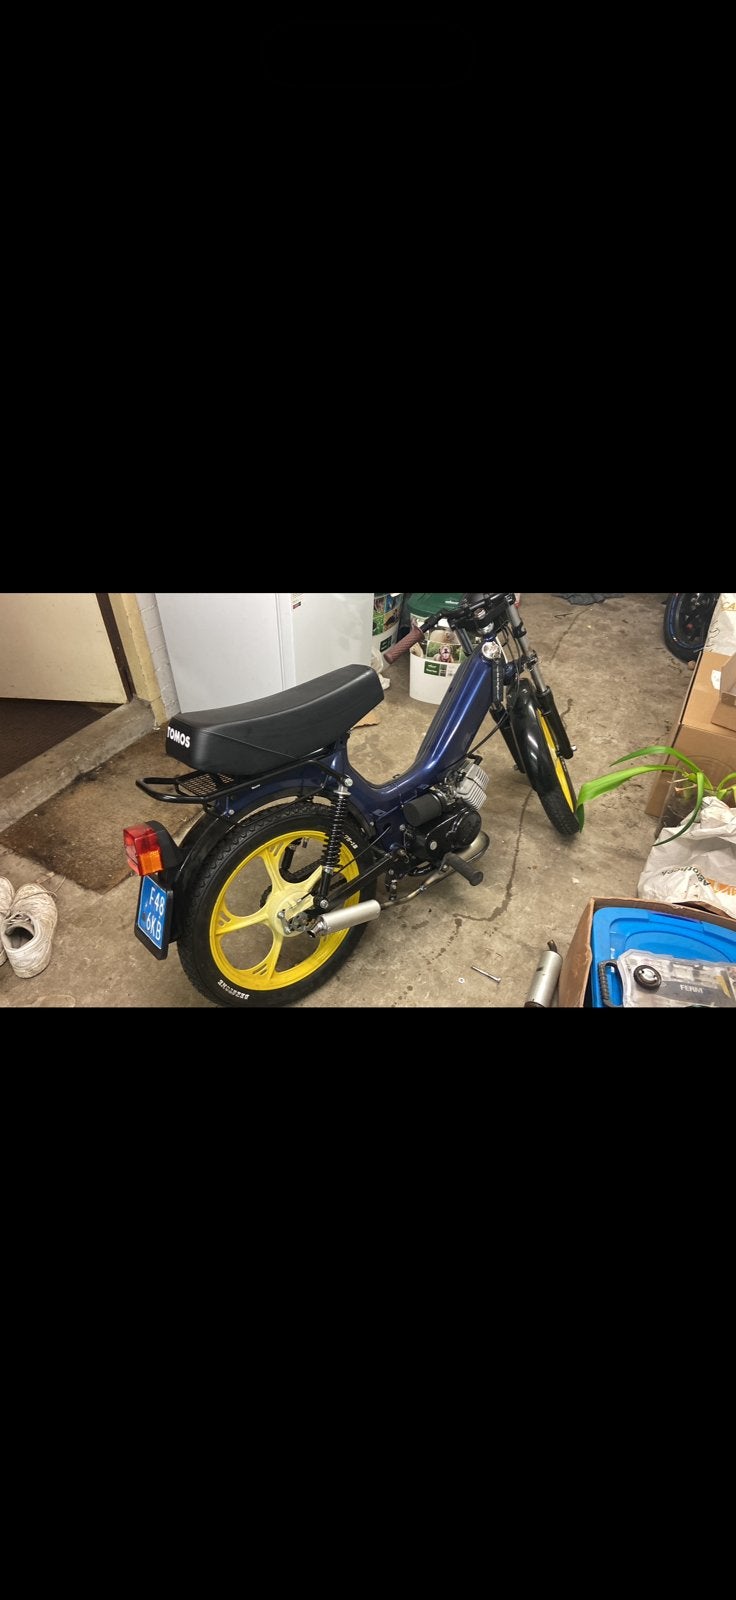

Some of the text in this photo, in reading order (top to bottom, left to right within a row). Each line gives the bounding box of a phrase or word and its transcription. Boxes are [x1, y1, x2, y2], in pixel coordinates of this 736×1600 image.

[166, 726, 191, 748] TOMOS
[149, 886, 165, 916] F48
[146, 911, 161, 941] 6KB
